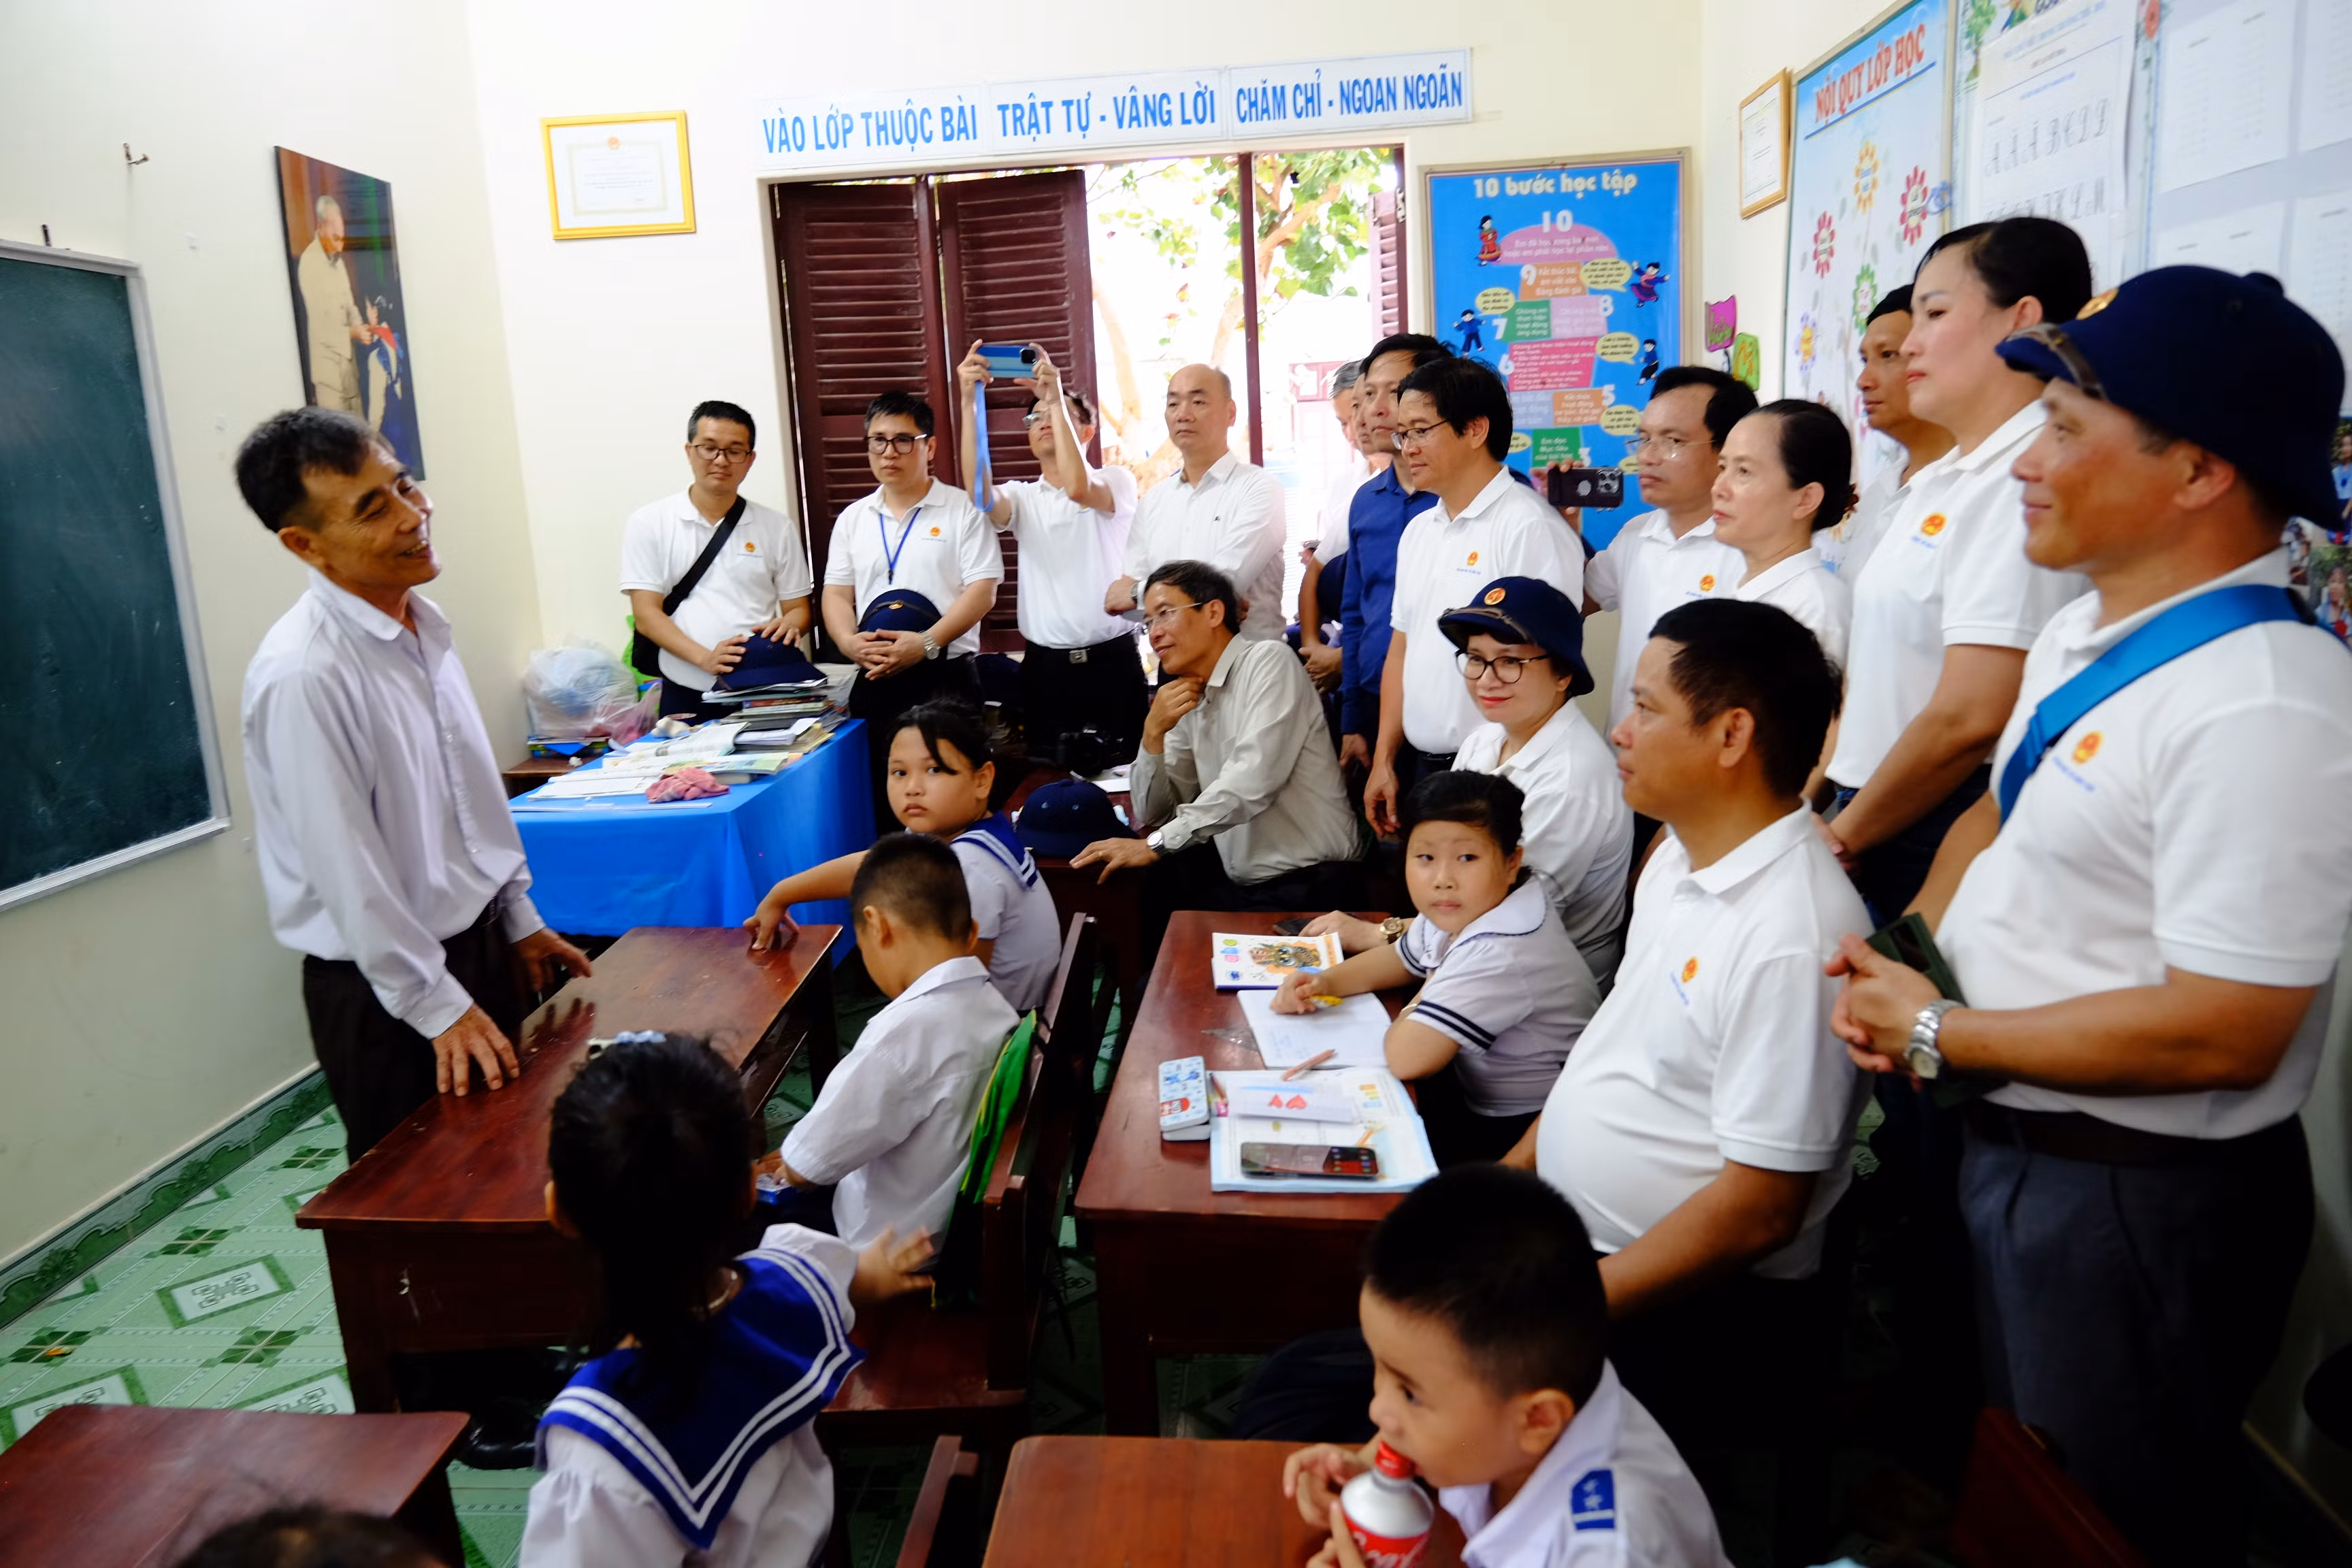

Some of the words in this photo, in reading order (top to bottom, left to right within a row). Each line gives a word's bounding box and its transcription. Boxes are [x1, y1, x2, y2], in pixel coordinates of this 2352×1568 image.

[1815, 74, 1836, 125] NỘI
[1839, 61, 1865, 115] QUY
[1866, 40, 1892, 93] LỚP
[1894, 22, 1925, 78] HỌC
[1236, 78, 1287, 123] CHĂM
[1292, 67, 1322, 120] CHỈ
[1339, 75, 1398, 115] NGOAN
[1403, 63, 1462, 111] NGOÃN
[997, 92, 1054, 142] TRẬT
[1062, 91, 1092, 140] TỰ
[1113, 85, 1173, 129] VÂNG
[1179, 80, 1215, 125] LỜI
[762, 107, 805, 153] VÀO
[813, 103, 853, 150] LỚP
[860, 98, 933, 152] THUỘC
[941, 95, 977, 142] BÀI
[1473, 177, 1499, 198] 10
[1505, 174, 1555, 197] bước
[1561, 172, 1596, 199] học
[1601, 169, 1637, 197] tập
[1542, 209, 1573, 233] 10
[1520, 264, 1537, 286] 9
[1599, 294, 1614, 316] 8
[1491, 317, 1508, 340] 7
[1498, 353, 1515, 375] 6
[1601, 384, 1616, 406] 5
